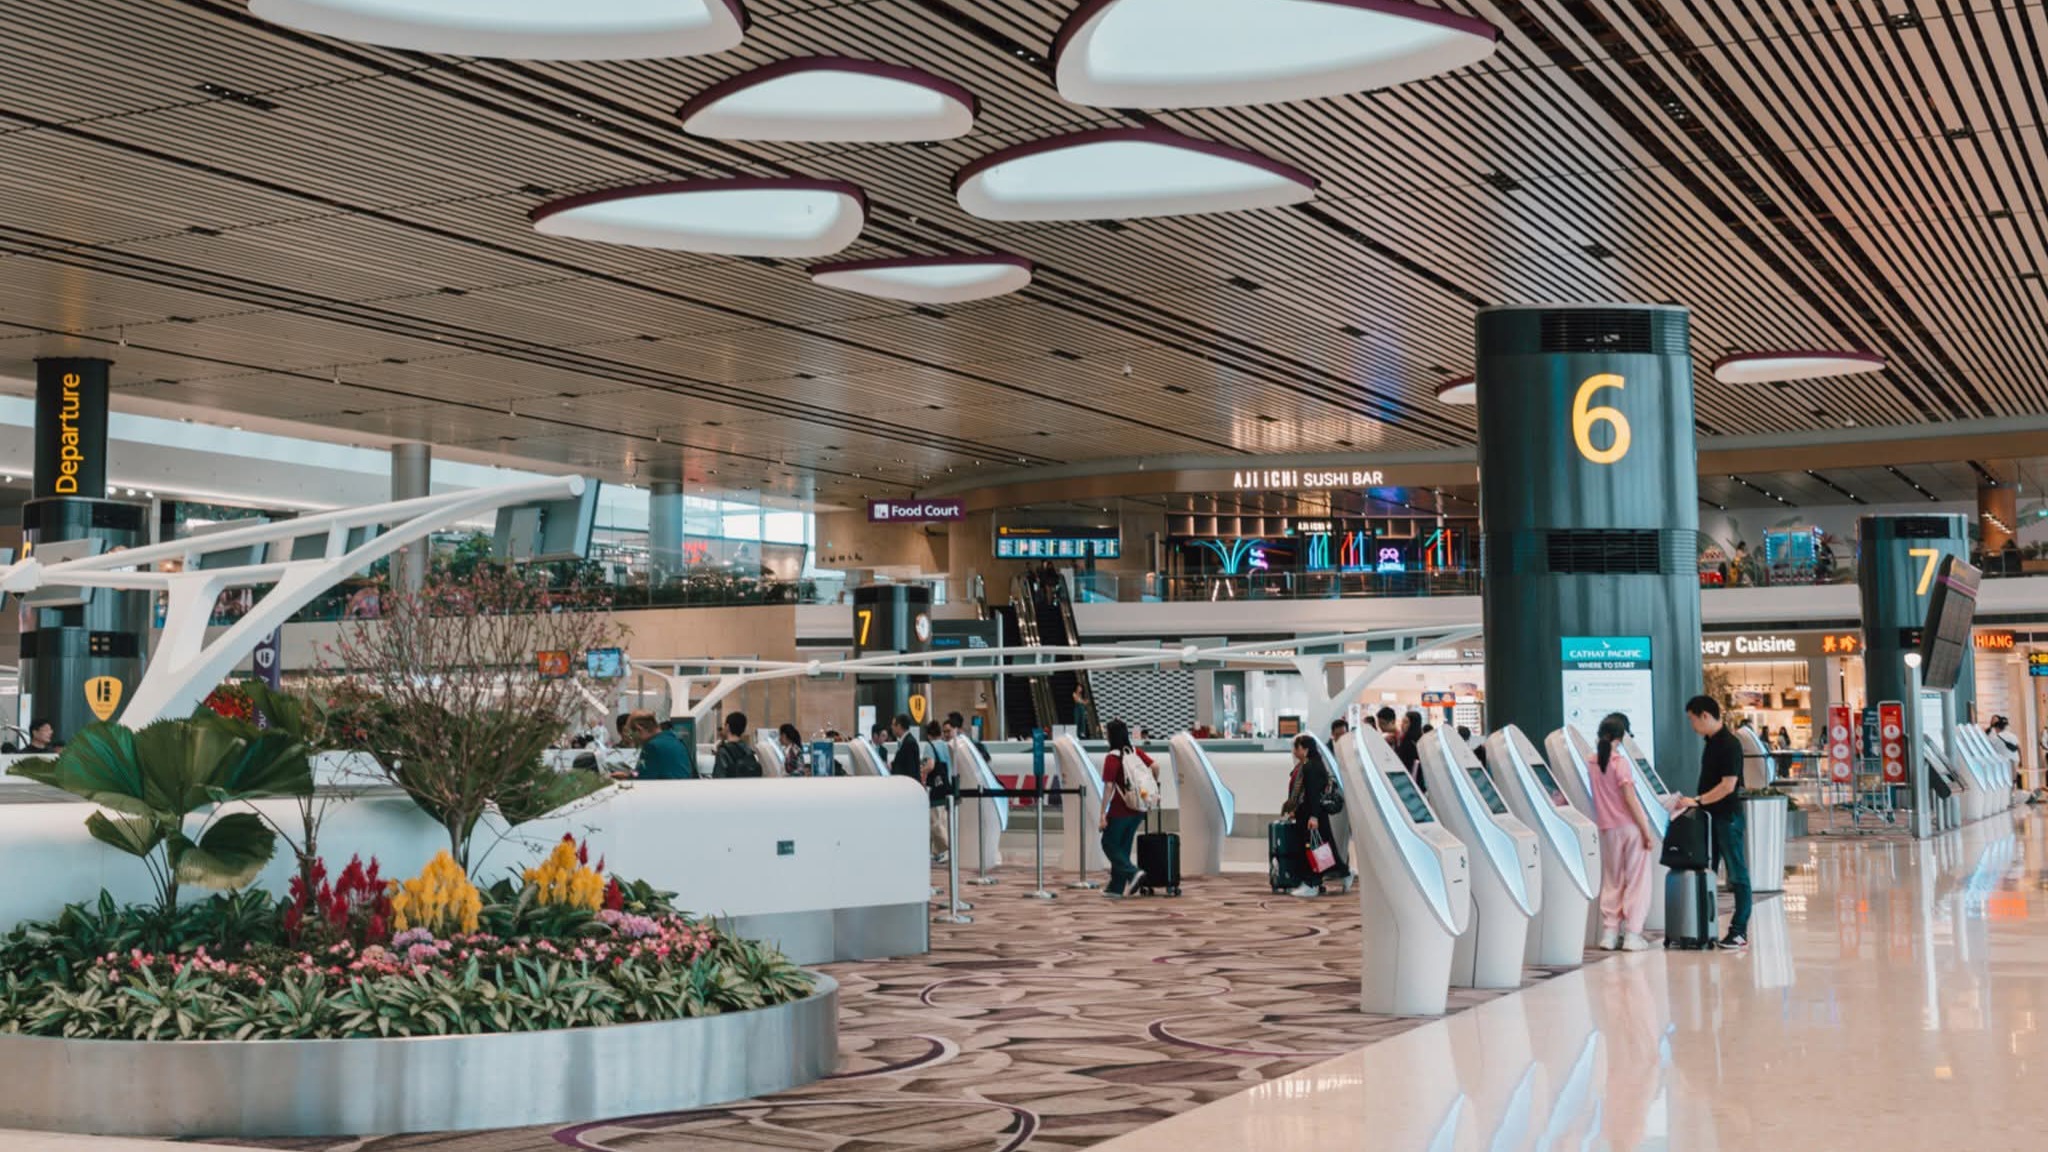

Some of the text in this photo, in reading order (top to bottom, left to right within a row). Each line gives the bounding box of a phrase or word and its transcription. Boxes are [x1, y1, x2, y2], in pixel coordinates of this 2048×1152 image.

[1572, 373, 1631, 464] 6
[55, 372, 84, 494] Departure
[1303, 472, 1349, 487] SUSHI
[1352, 471, 1383, 485] BAR
[891, 504, 959, 517] Food Court
[1908, 548, 1939, 595] 7
[858, 610, 872, 646] 7
[1735, 636, 1796, 653] Cuisine
[1975, 634, 2014, 649] HIANG
[1569, 650, 1642, 658] CATHAY PACIFIC
